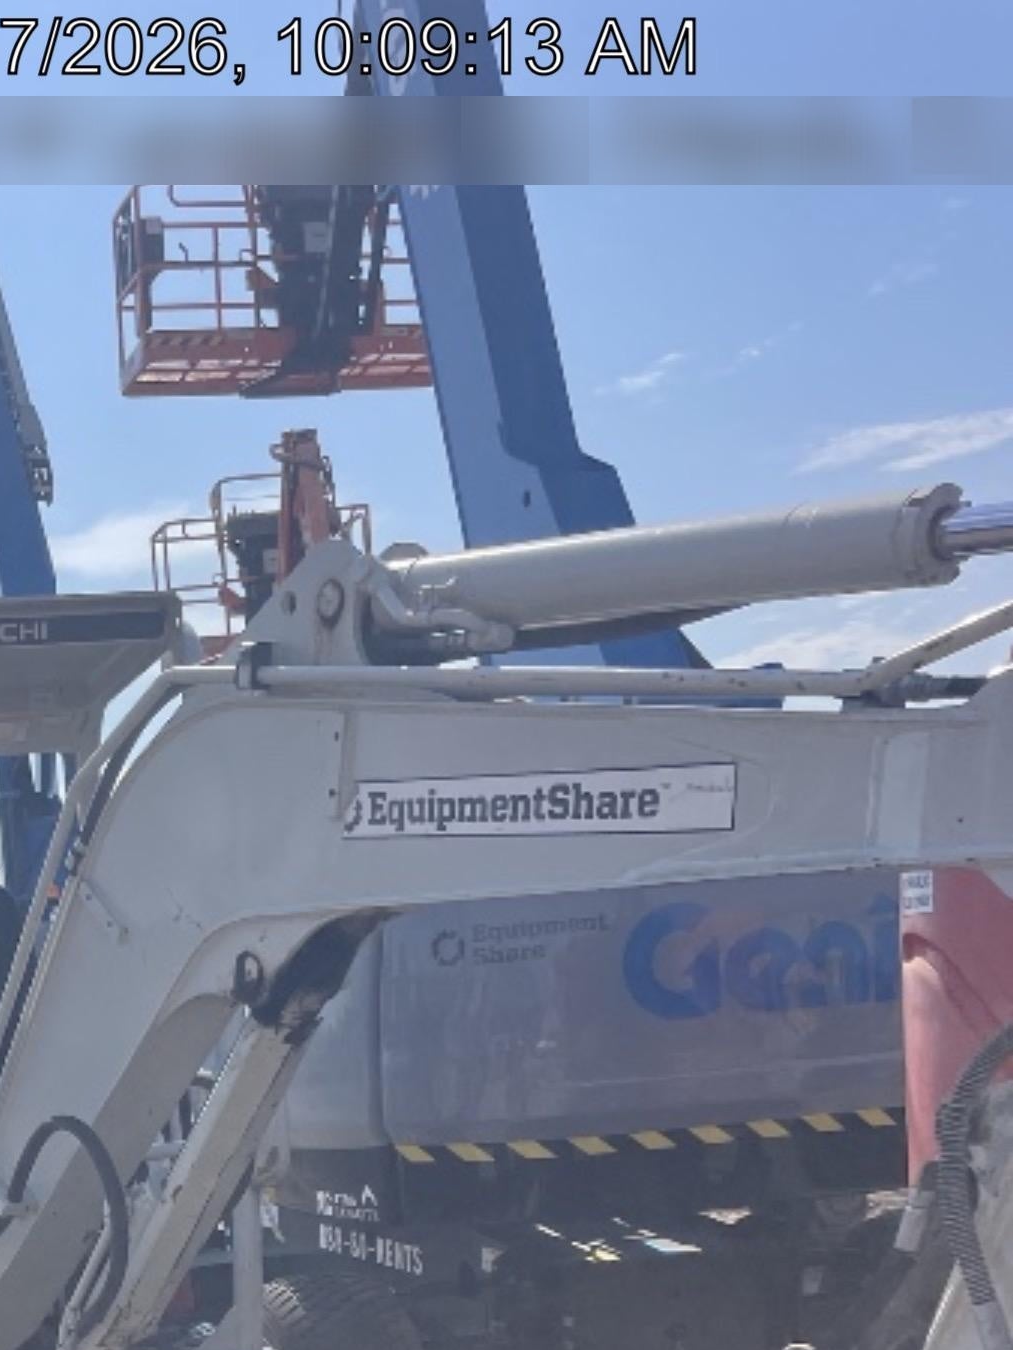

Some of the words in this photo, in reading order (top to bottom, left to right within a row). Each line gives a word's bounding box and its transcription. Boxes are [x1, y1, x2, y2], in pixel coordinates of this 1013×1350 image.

[366, 783, 661, 832] EquipmentShare
[472, 913, 611, 943] Equipment
[472, 941, 547, 966] Share
[622, 892, 901, 1020] Geni
